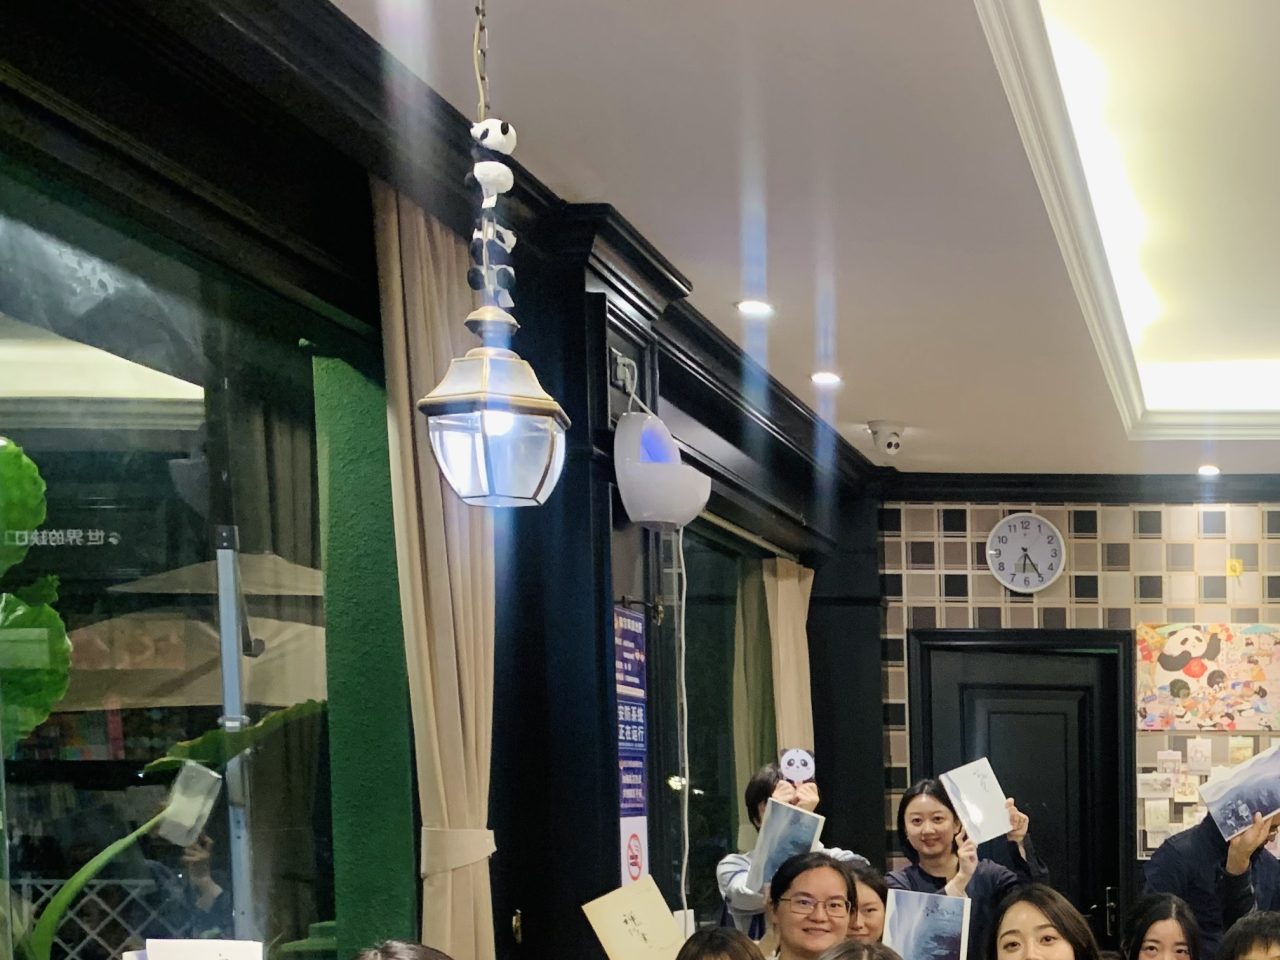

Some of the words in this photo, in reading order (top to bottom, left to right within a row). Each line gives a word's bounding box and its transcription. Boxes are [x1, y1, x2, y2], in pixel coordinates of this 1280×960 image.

[1008, 524, 1017, 533] 11
[1020, 520, 1030, 530] 12
[1037, 524, 1042, 534] 1
[997, 535, 1008, 544] 10
[1047, 535, 1054, 544] 2
[994, 548, 1002, 558] 9
[1050, 548, 1058, 558] 3
[998, 562, 1005, 571] 8
[1047, 562, 1054, 571] 4
[1010, 573, 1017, 584] 7
[1024, 576, 1030, 586] 6
[1038, 573, 1044, 583] 5
[618, 724, 645, 742] 正在运行
